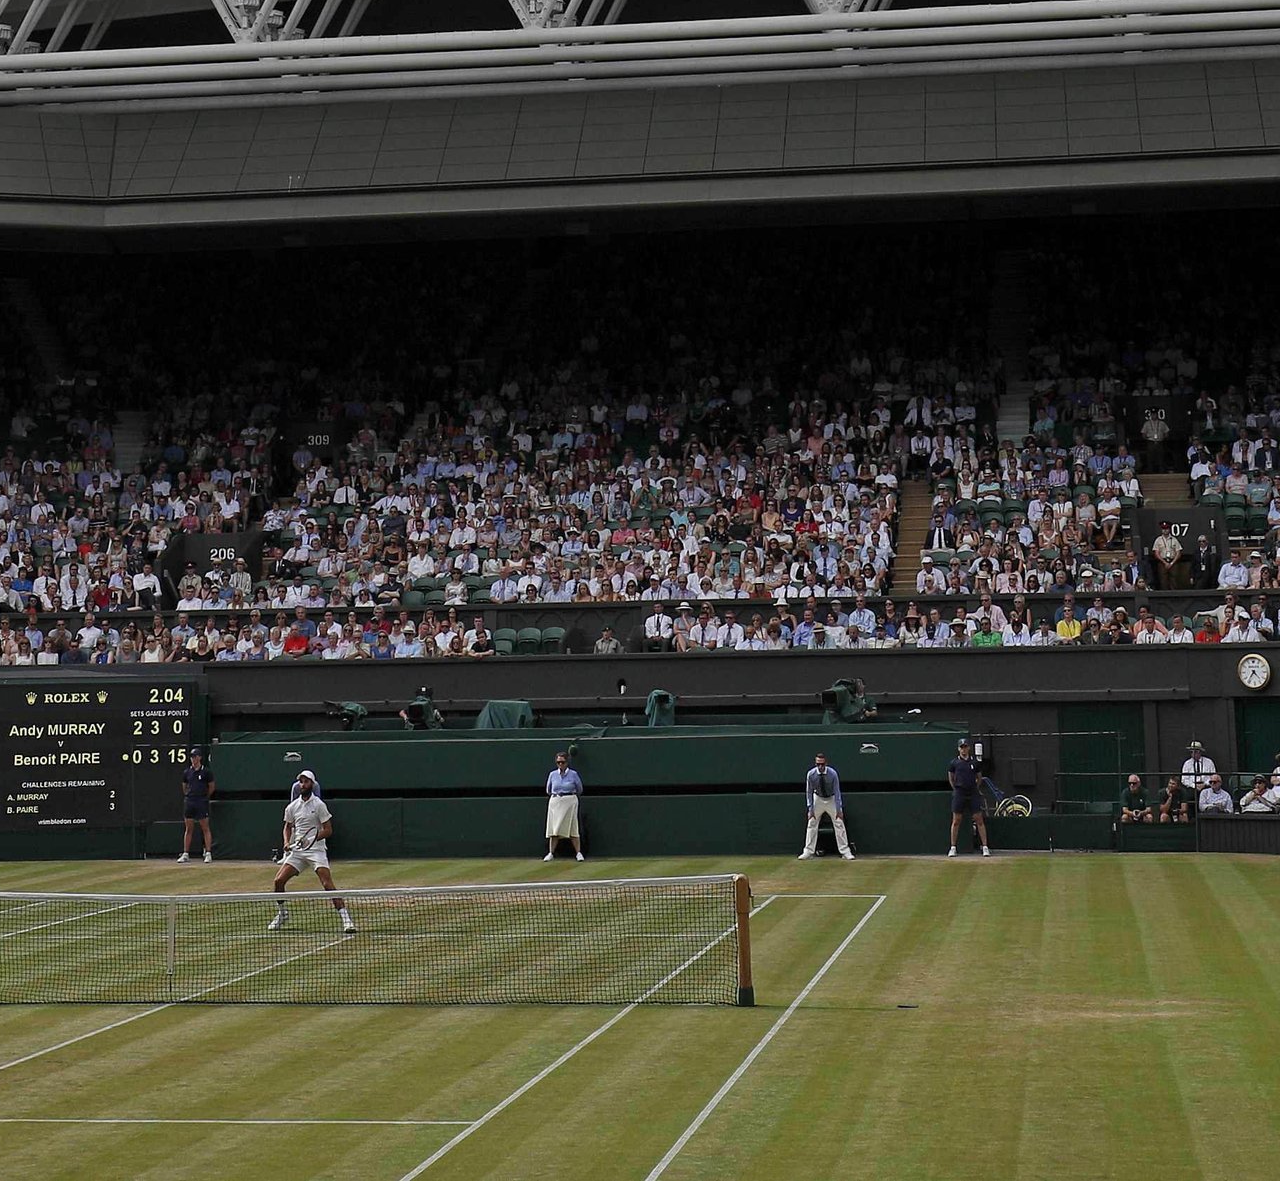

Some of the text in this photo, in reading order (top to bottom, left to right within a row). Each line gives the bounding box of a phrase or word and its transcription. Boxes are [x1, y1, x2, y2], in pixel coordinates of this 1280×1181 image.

[1144, 408, 1165, 420] 30
[307, 435, 330, 447] 309
[1171, 523, 1190, 537] 07
[210, 548, 235, 561] 206
[44, 693, 90, 704] ROLEX
[149, 688, 184, 703] 2.04
[167, 709, 189, 717] POINTS
[9, 723, 106, 739] Andy MURRAY
[133, 720, 183, 735] 2 3 0
[60, 752, 101, 765] PAIRE
[133, 748, 187, 764] 0 3 15
[21, 779, 106, 789] CHALLENGES REMAINING
[16, 793, 49, 801] MURRAY
[16, 806, 39, 814] PAIRE
